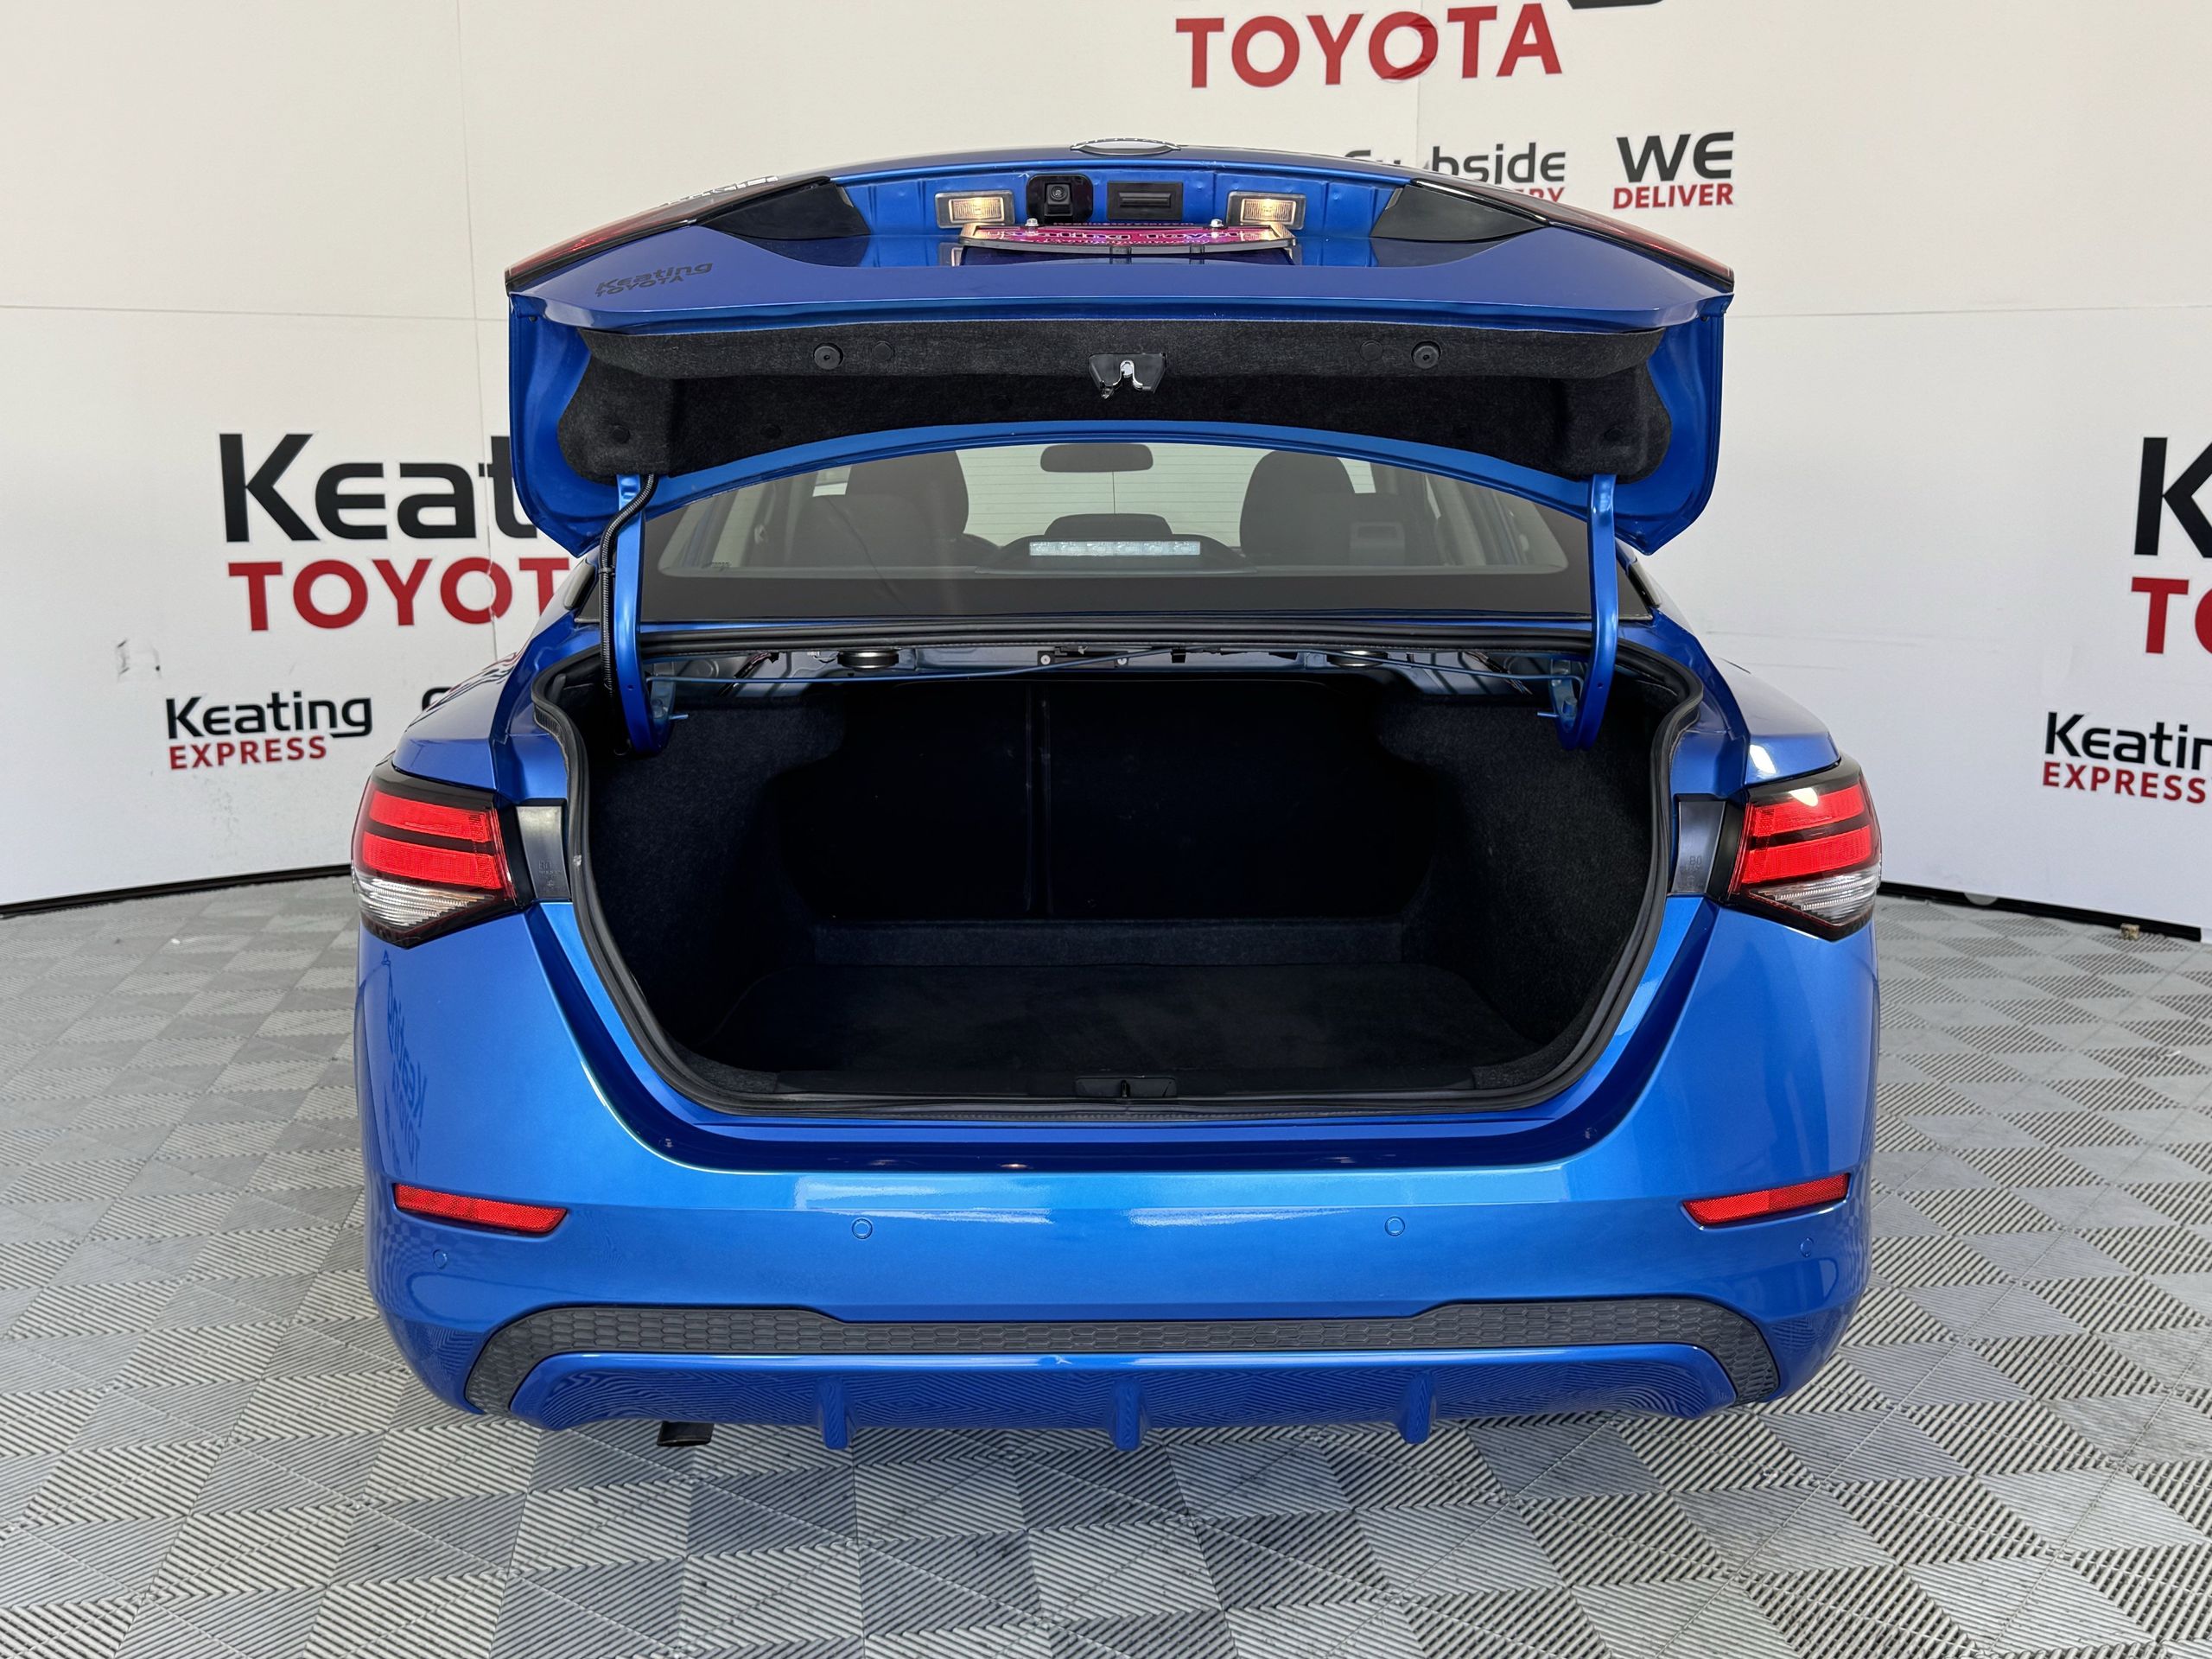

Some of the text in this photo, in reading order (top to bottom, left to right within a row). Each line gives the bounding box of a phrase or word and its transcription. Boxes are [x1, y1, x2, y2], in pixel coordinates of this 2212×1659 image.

[1175, 2, 1562, 88] TOYOTA
[1344, 130, 1734, 185] bside WE
[1612, 182, 1734, 210] DELIVER
[594, 276, 684, 297] TOYOTA
[596, 262, 713, 291] Keating
[165, 690, 373, 740] Keating
[168, 735, 327, 771] EXPRESS
[2042, 760, 2207, 804] EXPRESS
